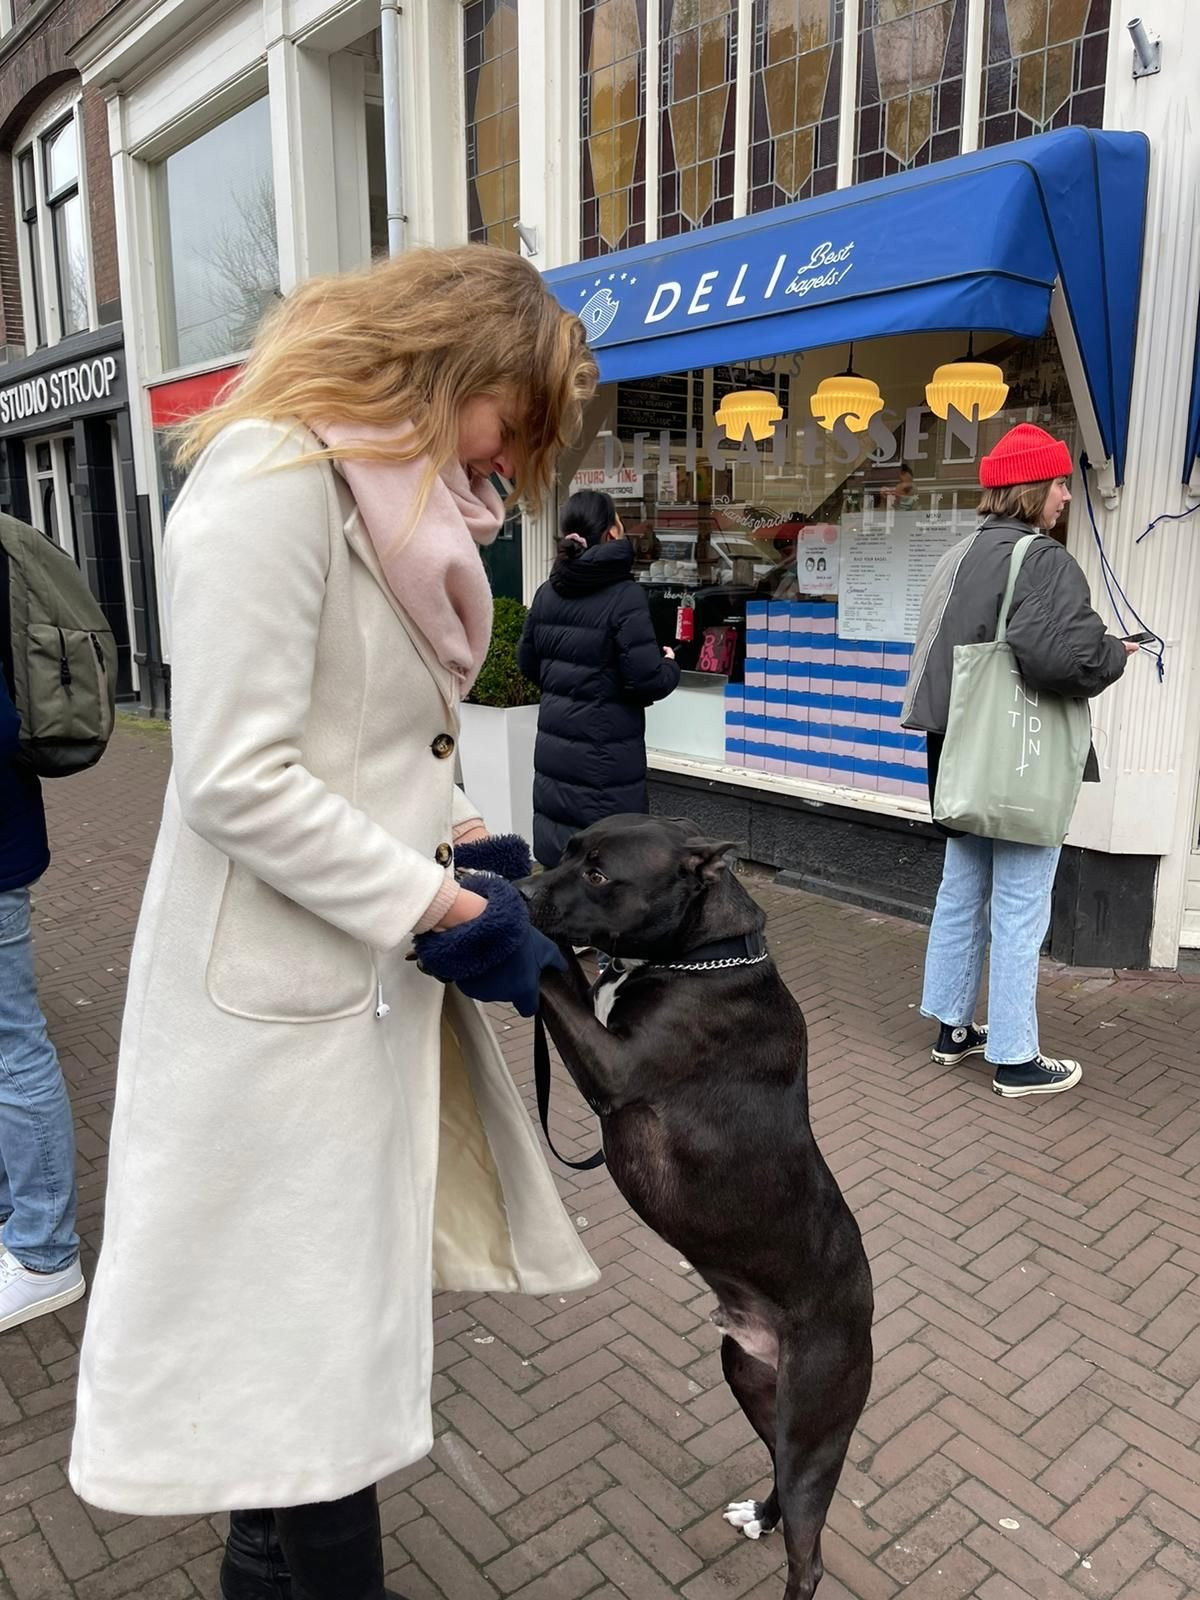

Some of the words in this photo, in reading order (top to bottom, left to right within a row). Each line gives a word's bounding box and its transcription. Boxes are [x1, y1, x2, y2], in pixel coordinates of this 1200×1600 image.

[785, 263, 853, 297] bagels!
[797, 241, 855, 274] Best
[644, 254, 787, 324] DELI
[0, 377, 48, 424] STUDIO
[50, 356, 116, 409] STROOP
